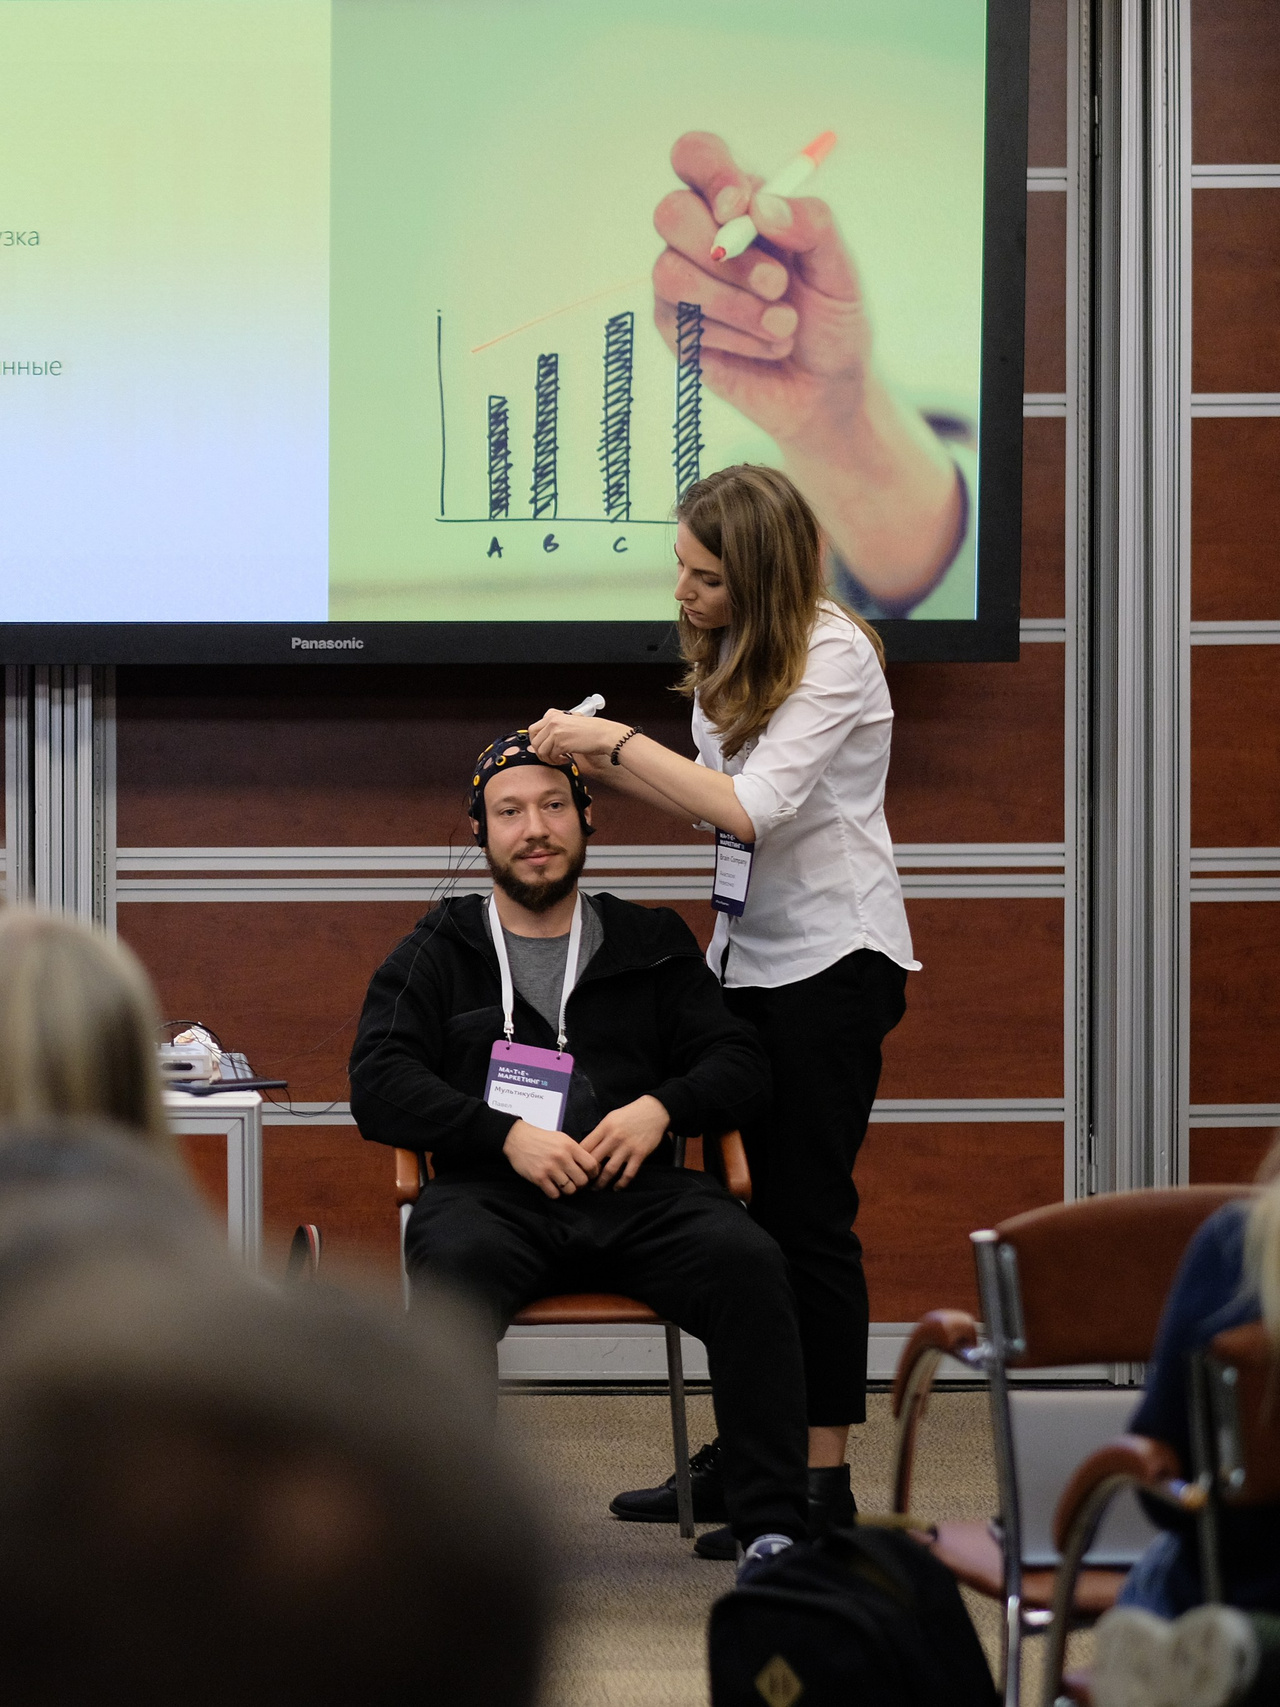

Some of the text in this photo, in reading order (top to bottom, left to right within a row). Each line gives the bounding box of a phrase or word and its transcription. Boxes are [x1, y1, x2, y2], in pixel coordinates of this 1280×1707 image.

[487, 536, 503, 559] A
[612, 536, 629, 553] C
[291, 636, 364, 650] Panasonic
[497, 1073, 540, 1085] МАРКЕТИНГ
